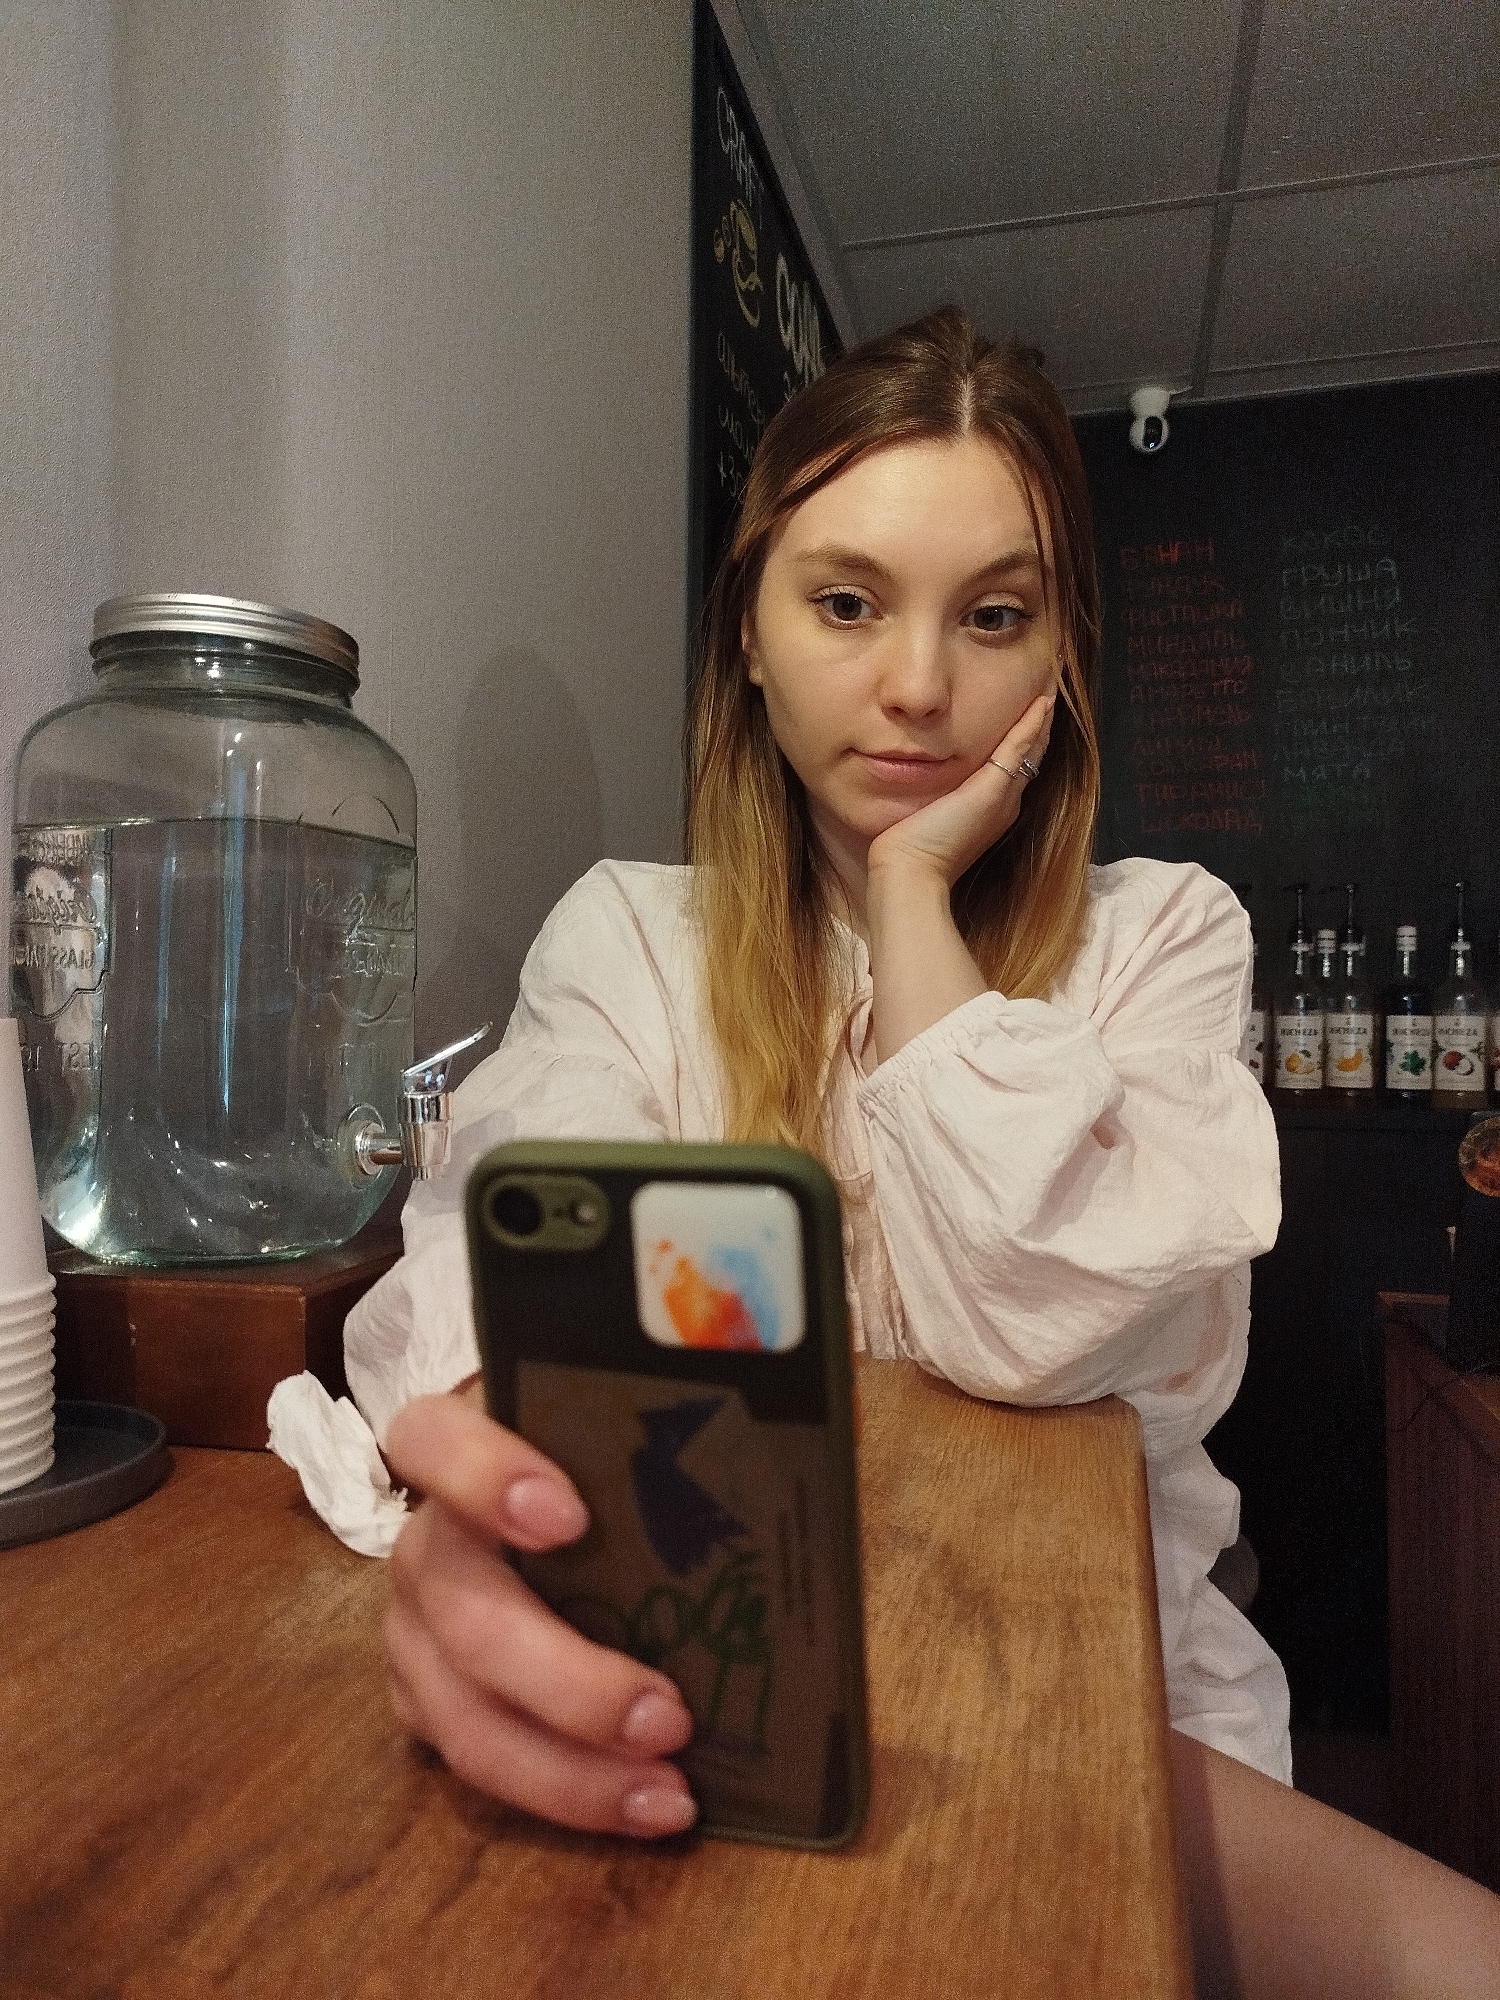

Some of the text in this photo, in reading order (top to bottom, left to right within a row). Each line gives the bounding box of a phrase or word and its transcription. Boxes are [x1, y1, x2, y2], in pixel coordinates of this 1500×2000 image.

[1281, 557, 1398, 588] ГРУША
[1279, 584, 1402, 620] ВИШНЯ
[1280, 616, 1418, 650] ПОНЧИК
[1280, 651, 1413, 684] ВАНИЛЬ
[1282, 763, 1372, 784] МЯТА
